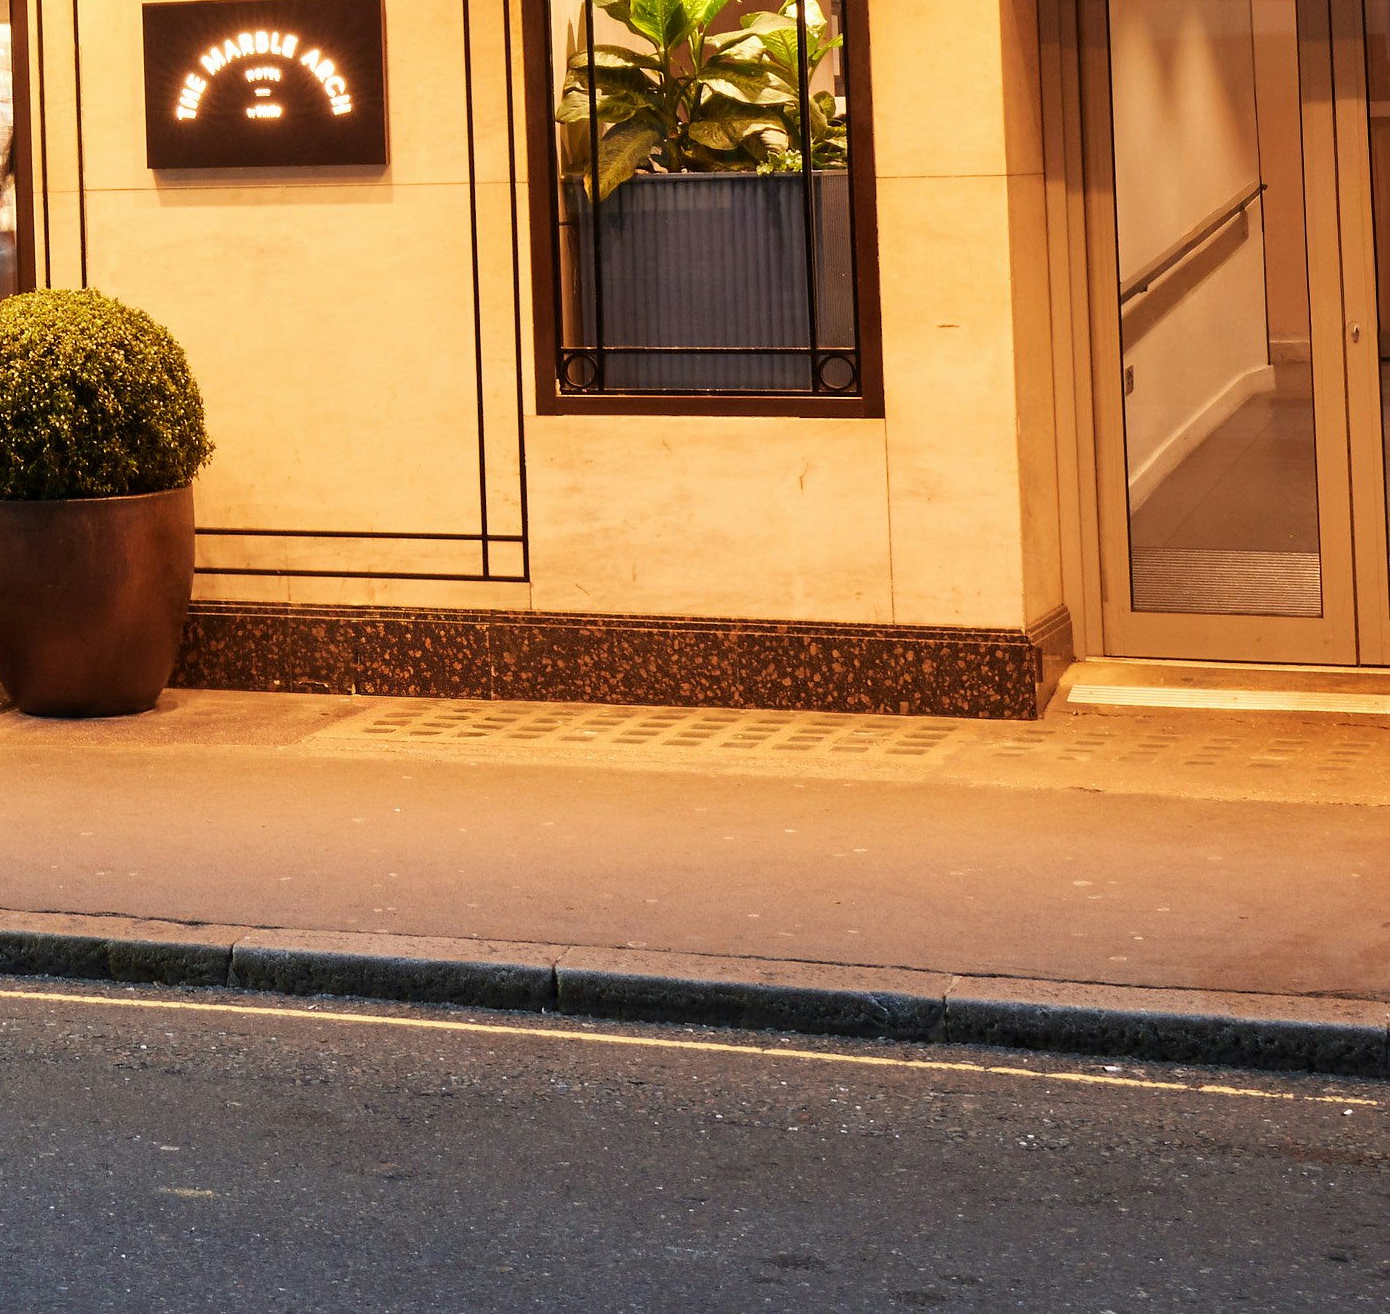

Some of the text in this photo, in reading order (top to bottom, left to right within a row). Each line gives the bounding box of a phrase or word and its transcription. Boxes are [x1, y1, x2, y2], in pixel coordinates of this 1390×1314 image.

[176, 30, 352, 121] THE MARBLE ARCH
